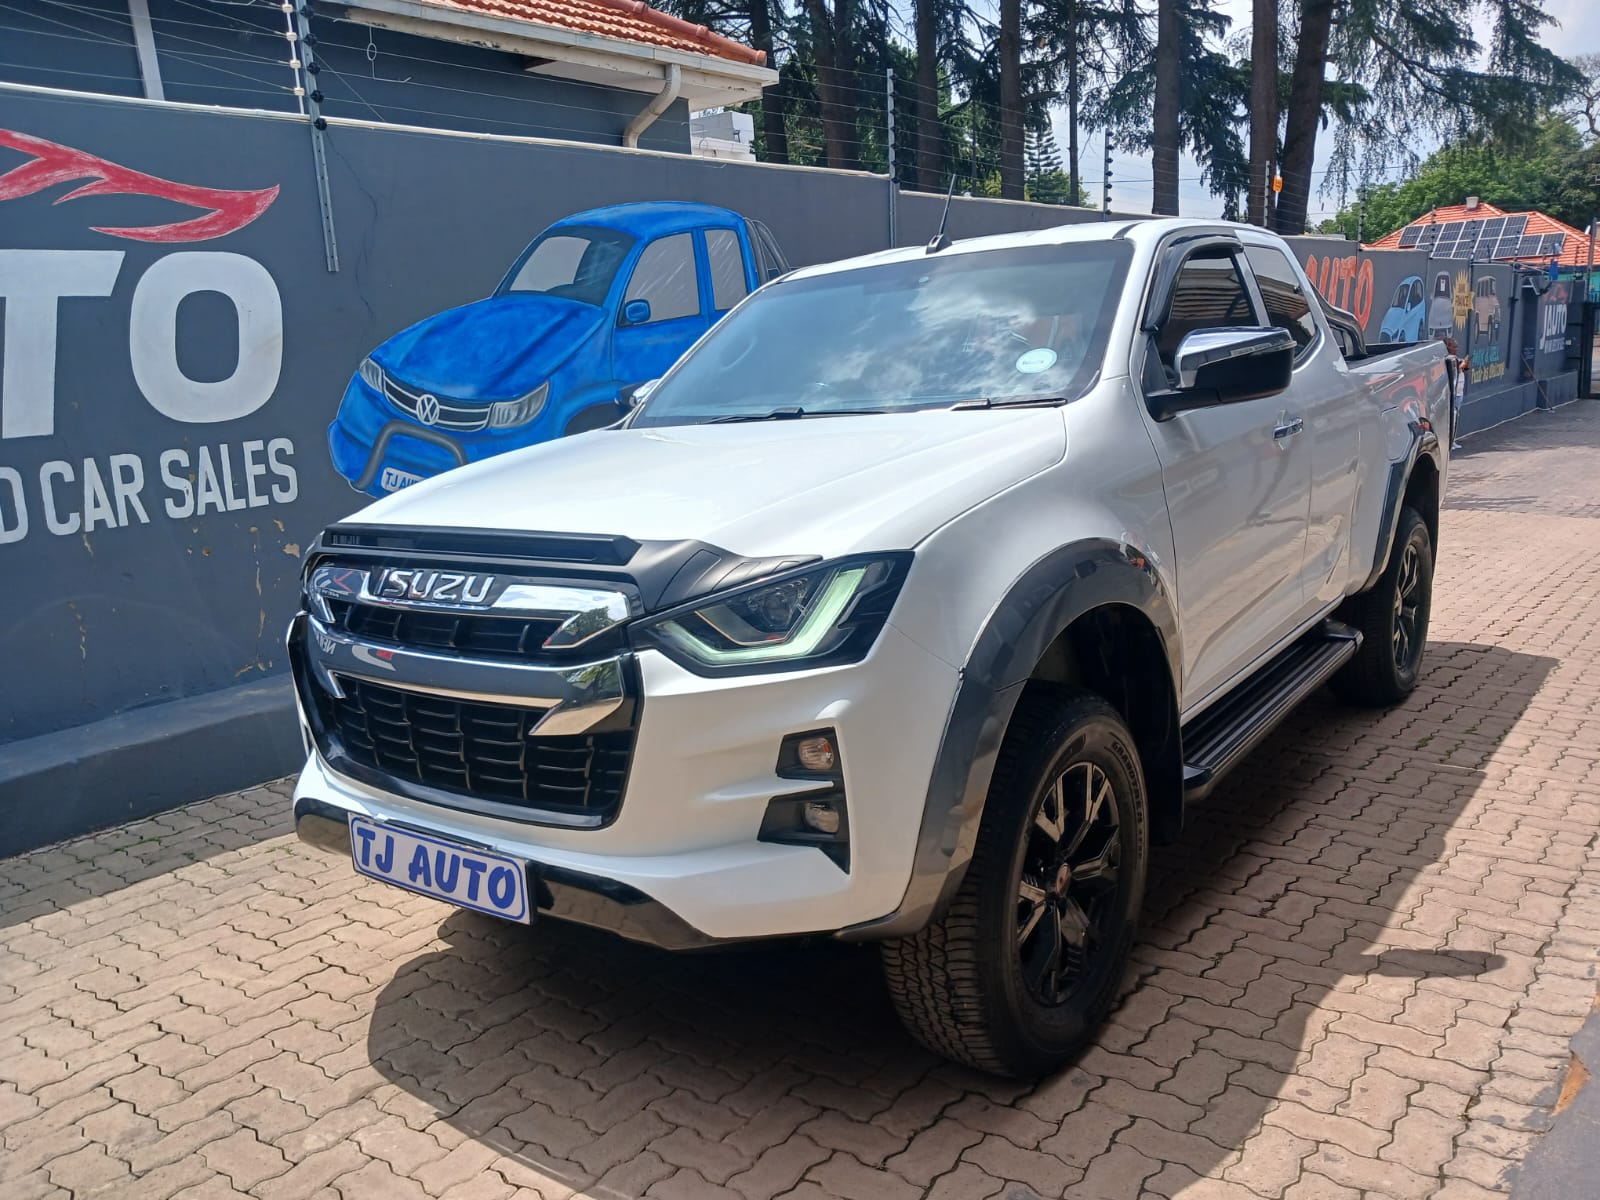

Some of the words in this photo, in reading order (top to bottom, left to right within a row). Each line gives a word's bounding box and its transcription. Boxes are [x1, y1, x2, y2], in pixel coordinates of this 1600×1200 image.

[39, 453, 150, 536] CAR
[160, 437, 299, 519] SALES
[386, 471, 399, 488] TJ
[371, 568, 496, 603] ISUZU
[356, 826, 395, 874] TJ
[408, 844, 516, 910] AUTO
